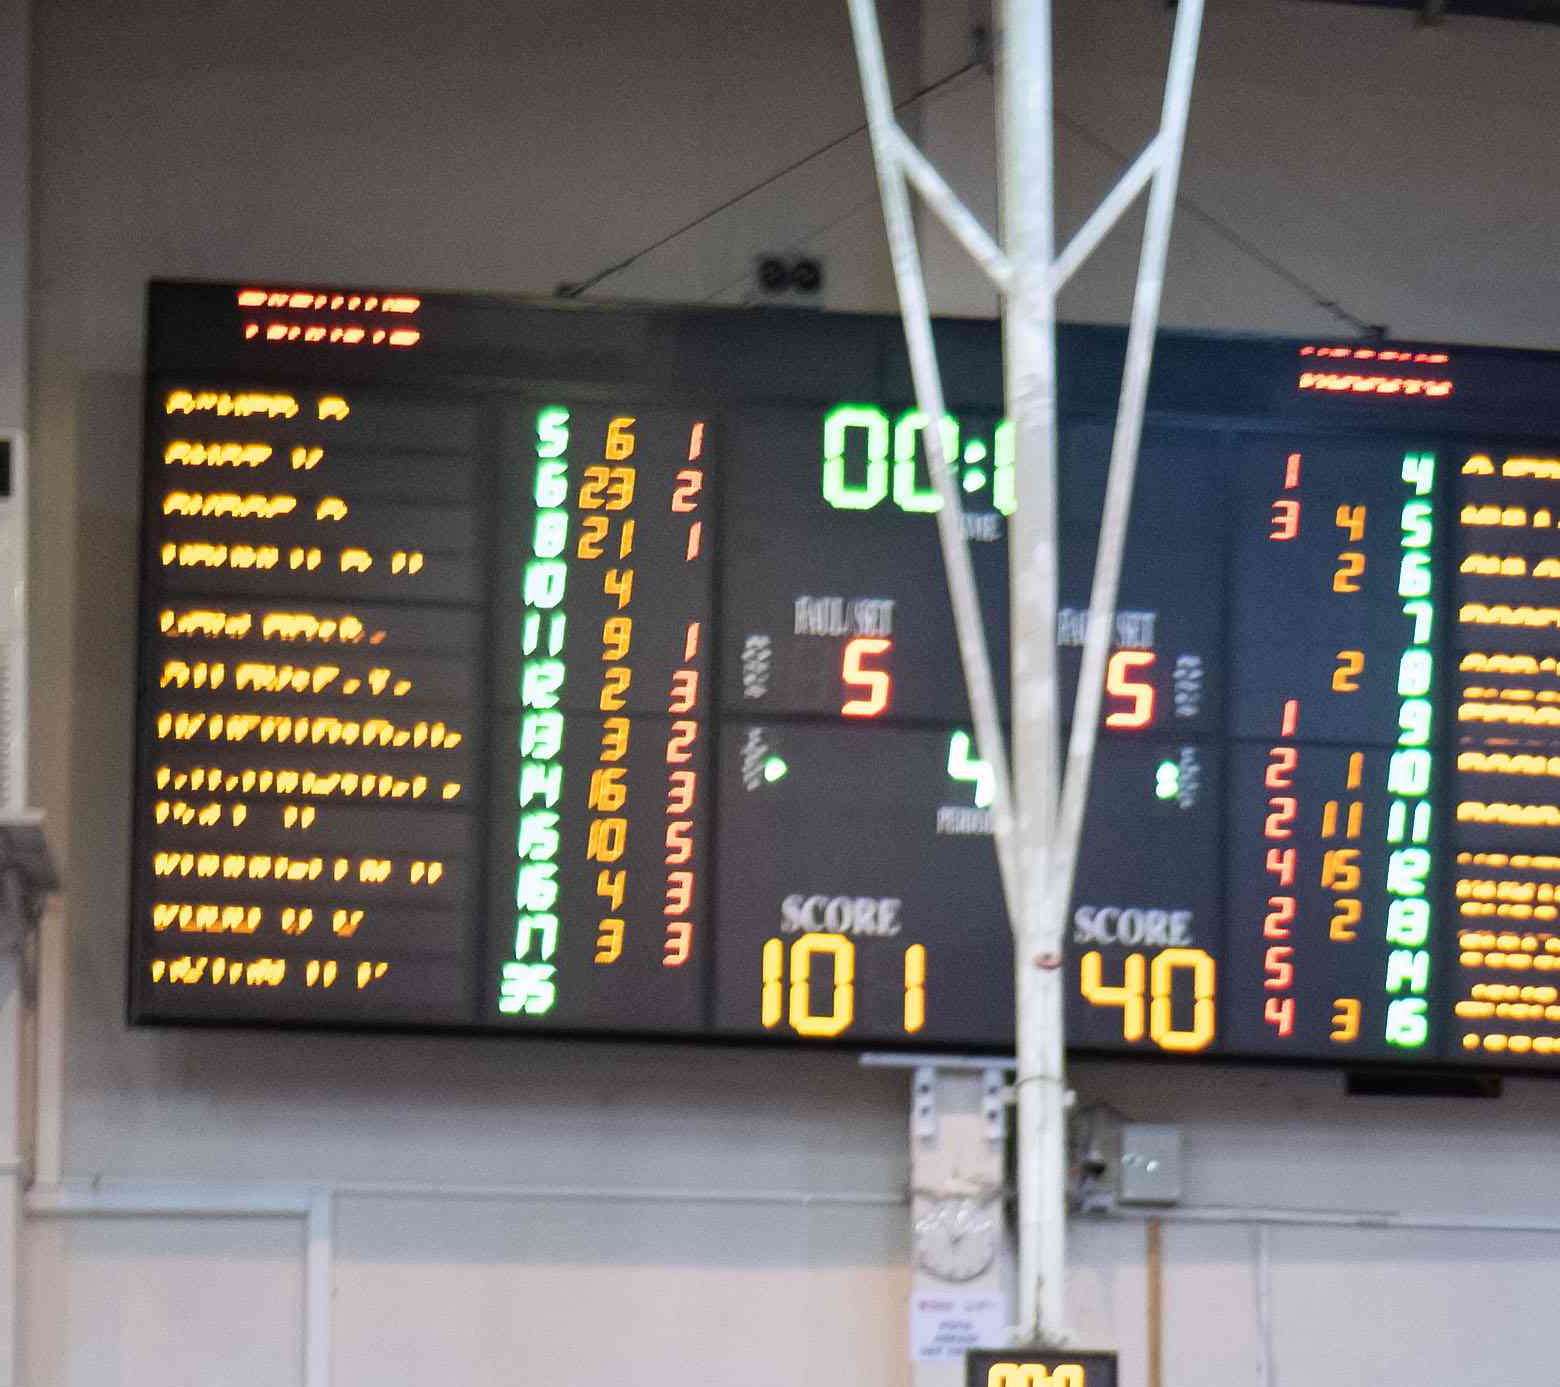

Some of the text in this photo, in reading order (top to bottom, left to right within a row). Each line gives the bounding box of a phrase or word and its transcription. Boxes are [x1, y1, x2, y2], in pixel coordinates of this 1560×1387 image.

[536, 408, 704, 460] 5 6 1
[535, 461, 703, 512] 6 23 2
[1284, 453, 1301, 489] 1
[1402, 452, 1435, 495] 4
[577, 516, 635, 560] 21
[686, 520, 702, 561] 1
[1270, 500, 1301, 540] 3
[1336, 504, 1366, 542] 4
[1400, 502, 1433, 548] 5
[524, 561, 633, 609] 10 4
[1333, 552, 1366, 592] 2
[1398, 551, 1432, 598] 6
[522, 611, 700, 663] 11 9 1
[1402, 600, 1433, 645] 7
[600, 667, 631, 711] 2
[668, 670, 699, 713] 3
[841, 637, 893, 718] 5
[1105, 650, 1157, 729] 5
[1331, 650, 1365, 692] 2
[600, 717, 630, 761] 3
[666, 720, 698, 763] 2
[1281, 699, 1300, 737] 1
[1397, 700, 1433, 746] 9
[666, 771, 697, 814] 3
[1265, 747, 1298, 788] 2
[1347, 751, 1364, 790] 1
[1387, 748, 1432, 796] 10
[587, 818, 628, 862] 10
[664, 821, 694, 864] 5
[1265, 797, 1298, 840] 2
[1321, 800, 1364, 840] 11
[1386, 800, 1432, 844] 11
[1266, 848, 1297, 887] 4
[597, 870, 626, 912] 4
[663, 871, 694, 916] 3
[780, 893, 904, 937] SCORE
[1073, 905, 1194, 947] SCORE
[1263, 896, 1297, 939] 2
[1329, 898, 1362, 941] 2
[594, 918, 625, 963] 3
[662, 921, 694, 967] 3
[761, 932, 927, 1037] 101
[1264, 946, 1295, 990] 5
[1080, 948, 1217, 1052] 40
[1264, 997, 1296, 1038] 4
[1330, 997, 1362, 1043] 3
